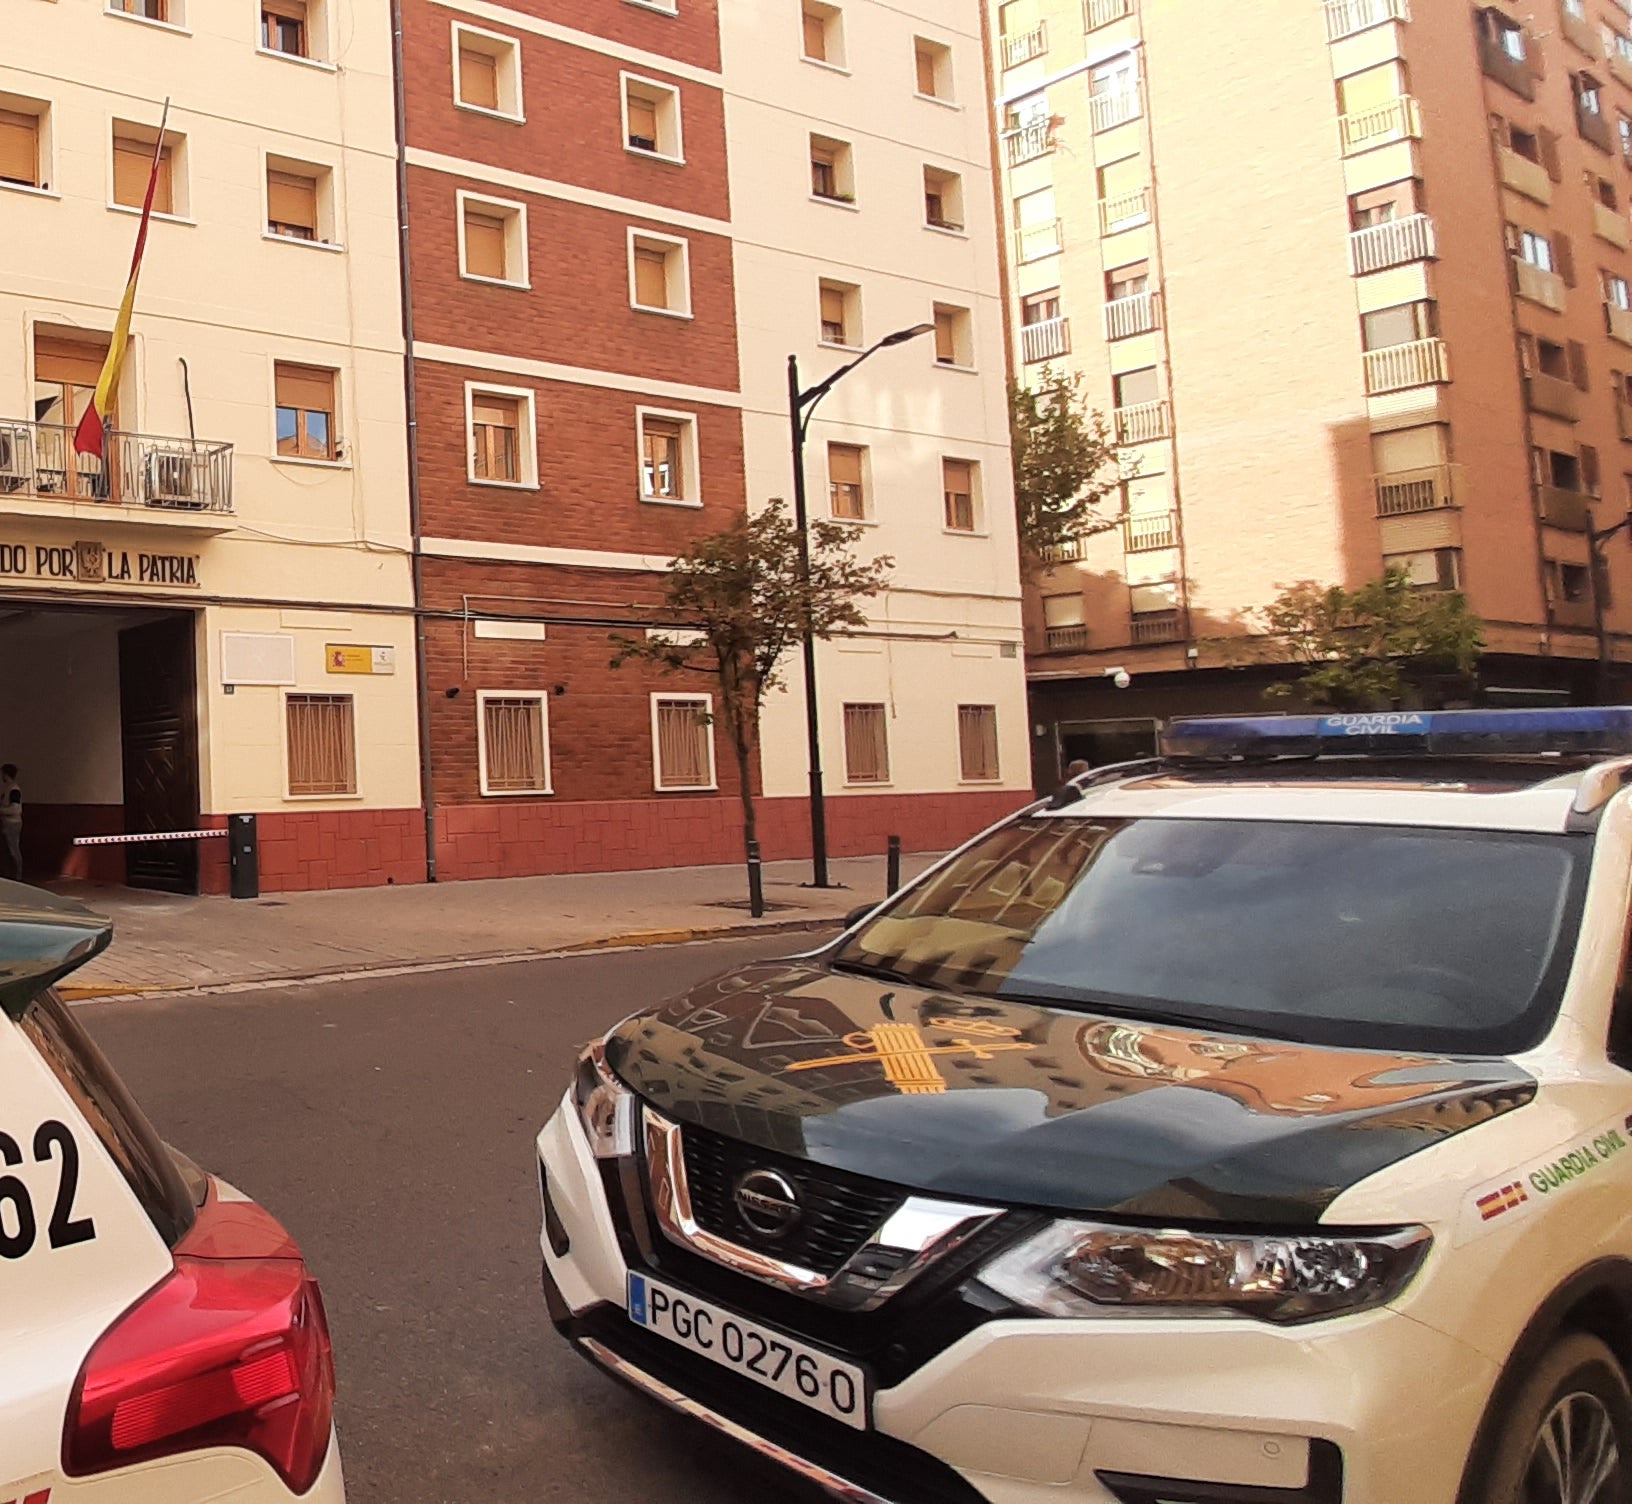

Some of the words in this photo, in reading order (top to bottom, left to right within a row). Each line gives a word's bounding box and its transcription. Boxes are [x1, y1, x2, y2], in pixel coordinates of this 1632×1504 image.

[35, 546, 74, 578] POR
[108, 551, 132, 580] LA
[138, 553, 197, 584] PATRIA
[1326, 714, 1424, 727] GUARDIA
[1344, 724, 1399, 735] CIVIL
[1528, 1145, 1599, 1194] GUARDIA
[1592, 1129, 1627, 1159] CIVIL
[650, 1287, 713, 1349] PGC
[721, 1321, 820, 1398] 0276
